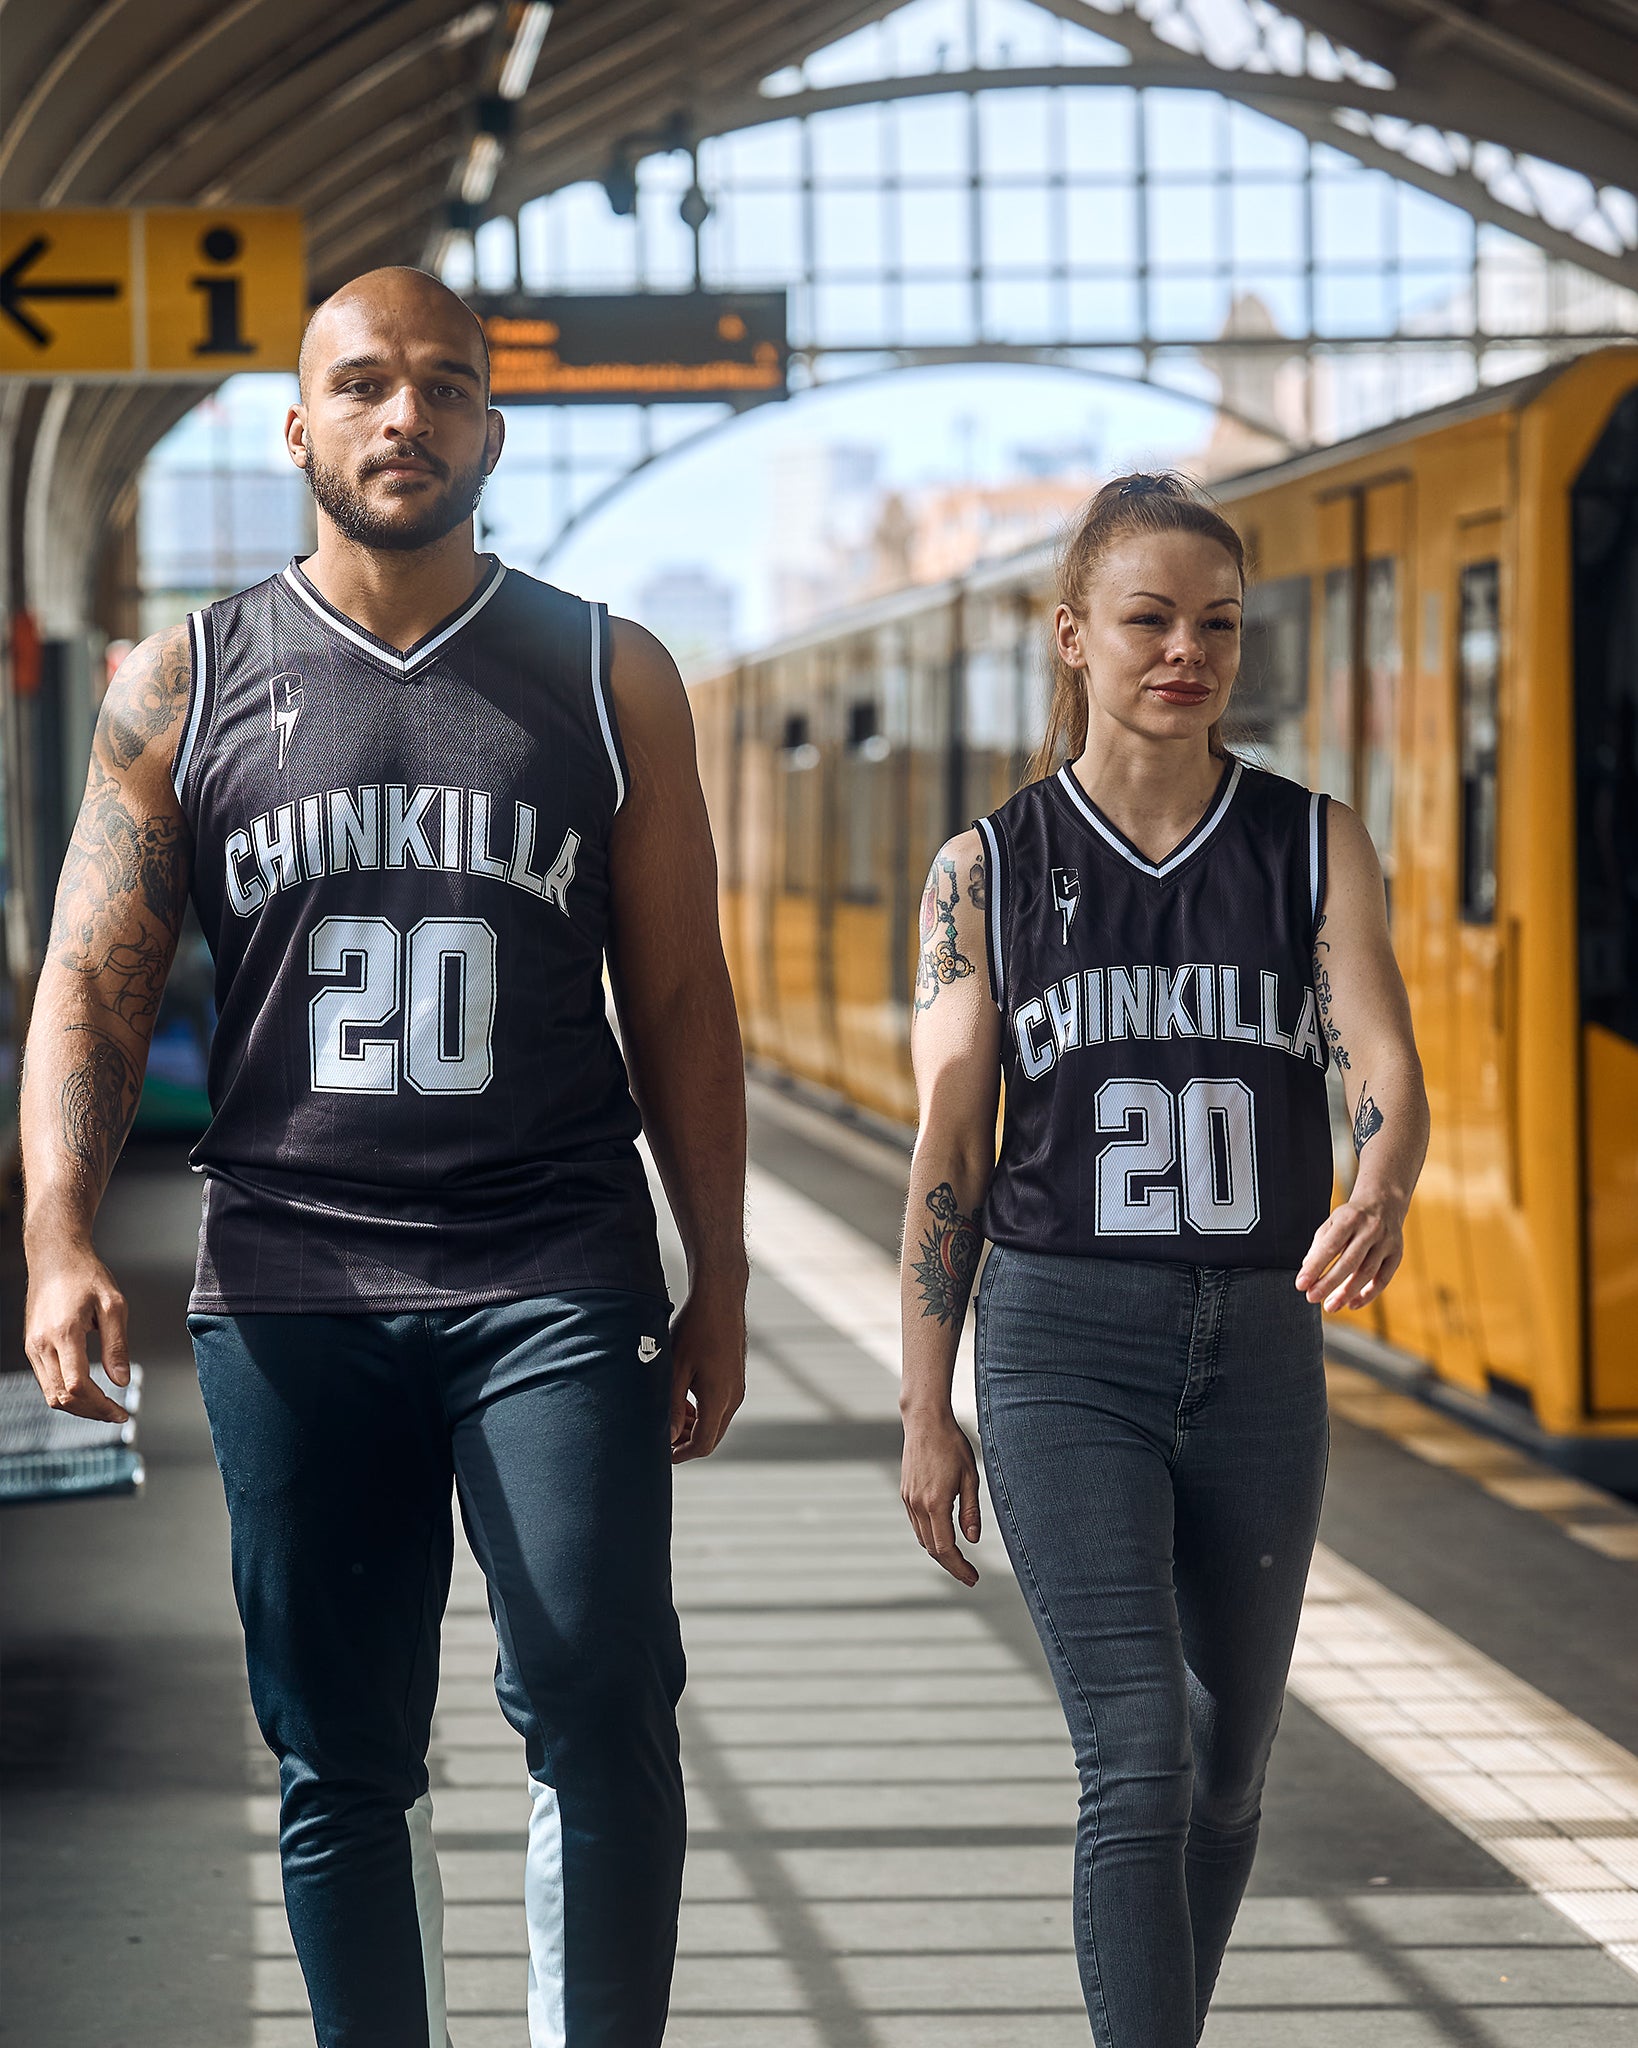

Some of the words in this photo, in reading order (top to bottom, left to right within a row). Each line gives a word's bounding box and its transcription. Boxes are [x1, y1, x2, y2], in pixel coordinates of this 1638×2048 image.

[225, 784, 581, 918] CHINKILLA
[308, 915, 497, 1095] 20
[1013, 963, 1325, 1081] CHINKILLA
[1094, 1077, 1260, 1236] 20
